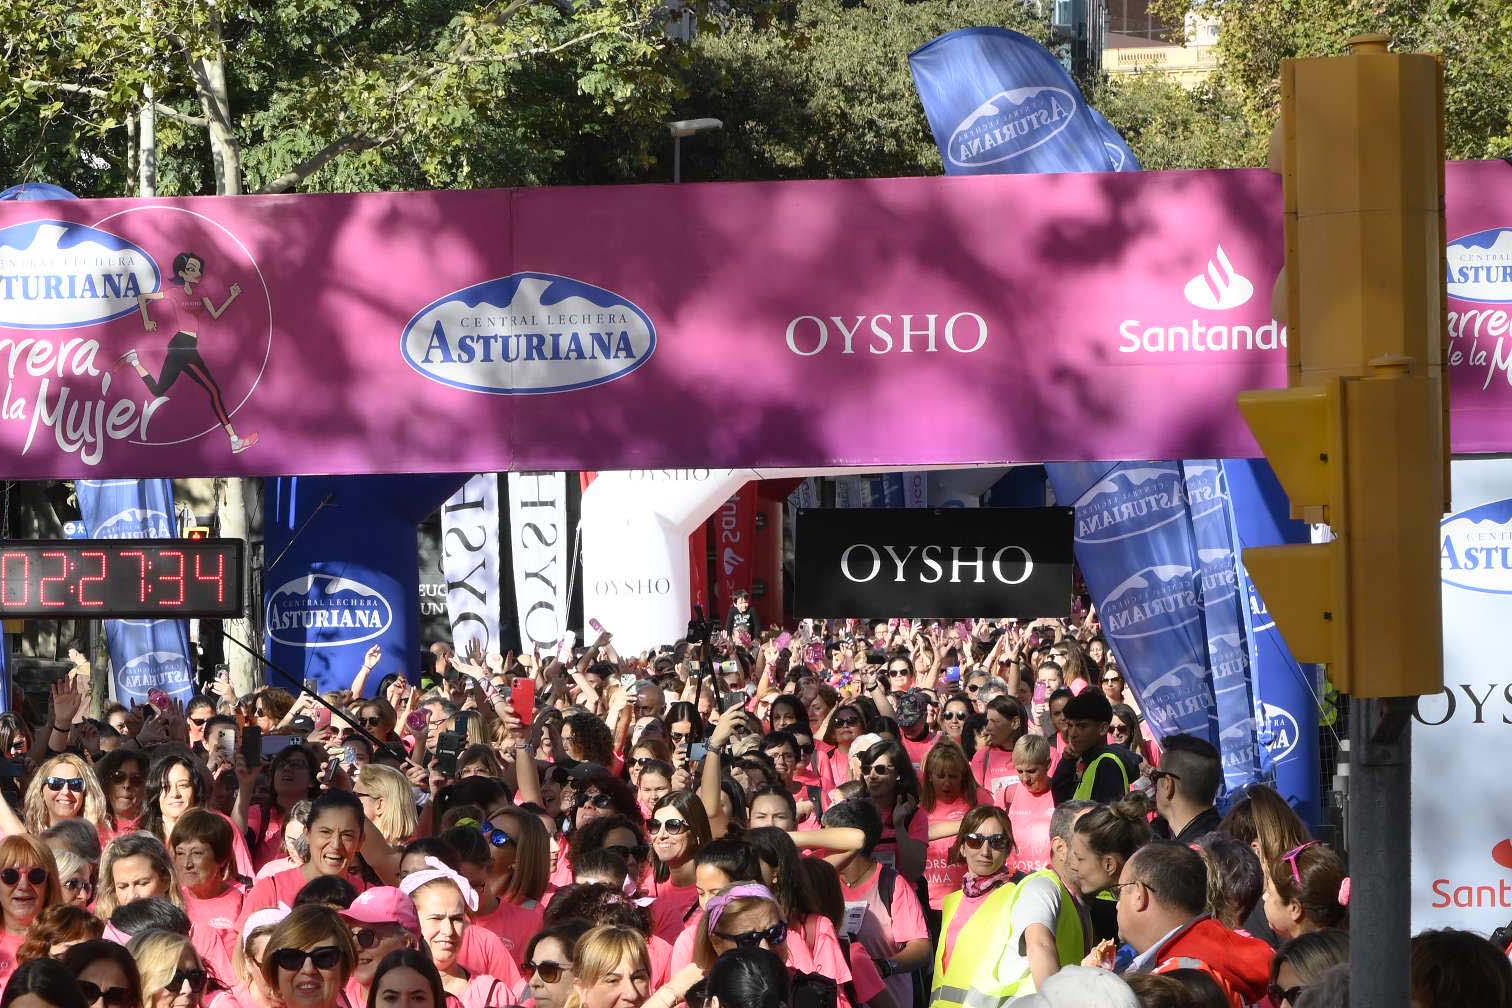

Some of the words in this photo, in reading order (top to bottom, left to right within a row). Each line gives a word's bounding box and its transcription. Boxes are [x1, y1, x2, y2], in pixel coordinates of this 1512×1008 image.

[460, 316, 538, 328] CENTRAL
[547, 314, 628, 326] LECHERA
[785, 312, 988, 356] OYSHO
[420, 318, 637, 365] ASTURIANA
[1470, 338, 1486, 366] la
[2, 382, 26, 420] la
[22, 371, 170, 465] Mujer
[840, 543, 1035, 585] OYSHO
[1, 552, 224, 606] 02:27:34
[595, 577, 670, 596] OYSHO
[328, 598, 378, 606] LECHERA
[268, 608, 382, 631] ASTURIANA
[925, 873, 951, 883] UMA
